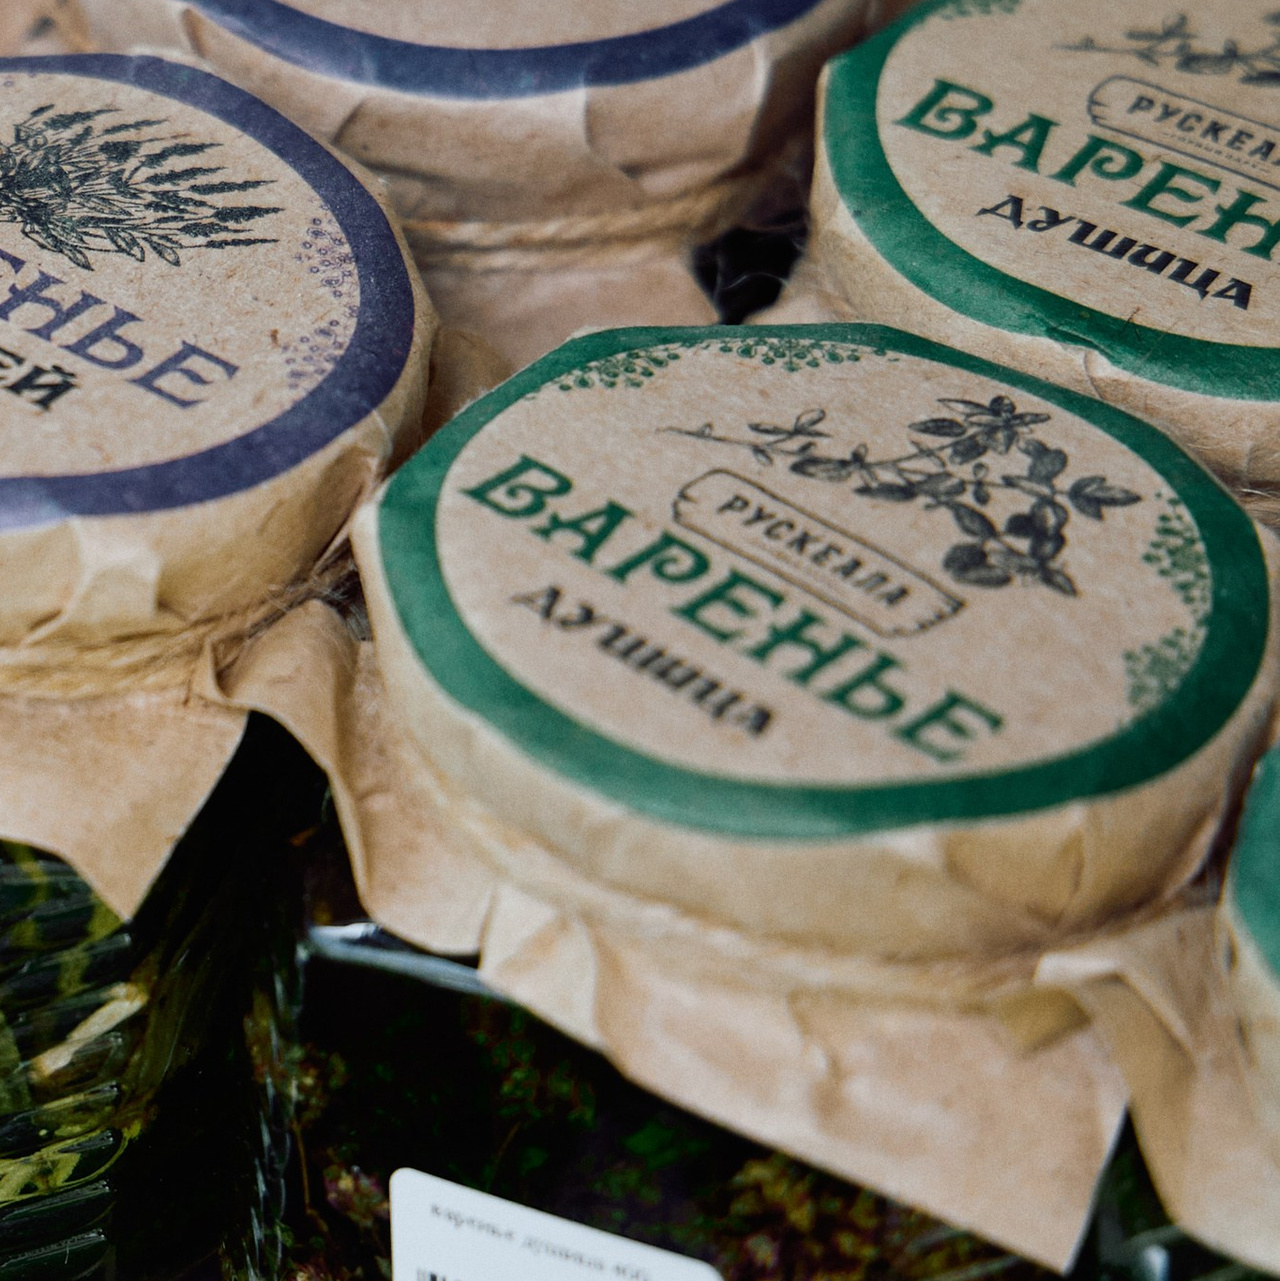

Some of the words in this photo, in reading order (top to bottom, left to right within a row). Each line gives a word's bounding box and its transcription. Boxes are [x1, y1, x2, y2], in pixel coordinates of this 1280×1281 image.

[976, 195, 1254, 311] ДУШИЦА
[457, 454, 1003, 763] ВАРЕНЬЕ
[716, 493, 911, 608] РУСКЕАЛА
[512, 584, 778, 740] ДУШИЦА
